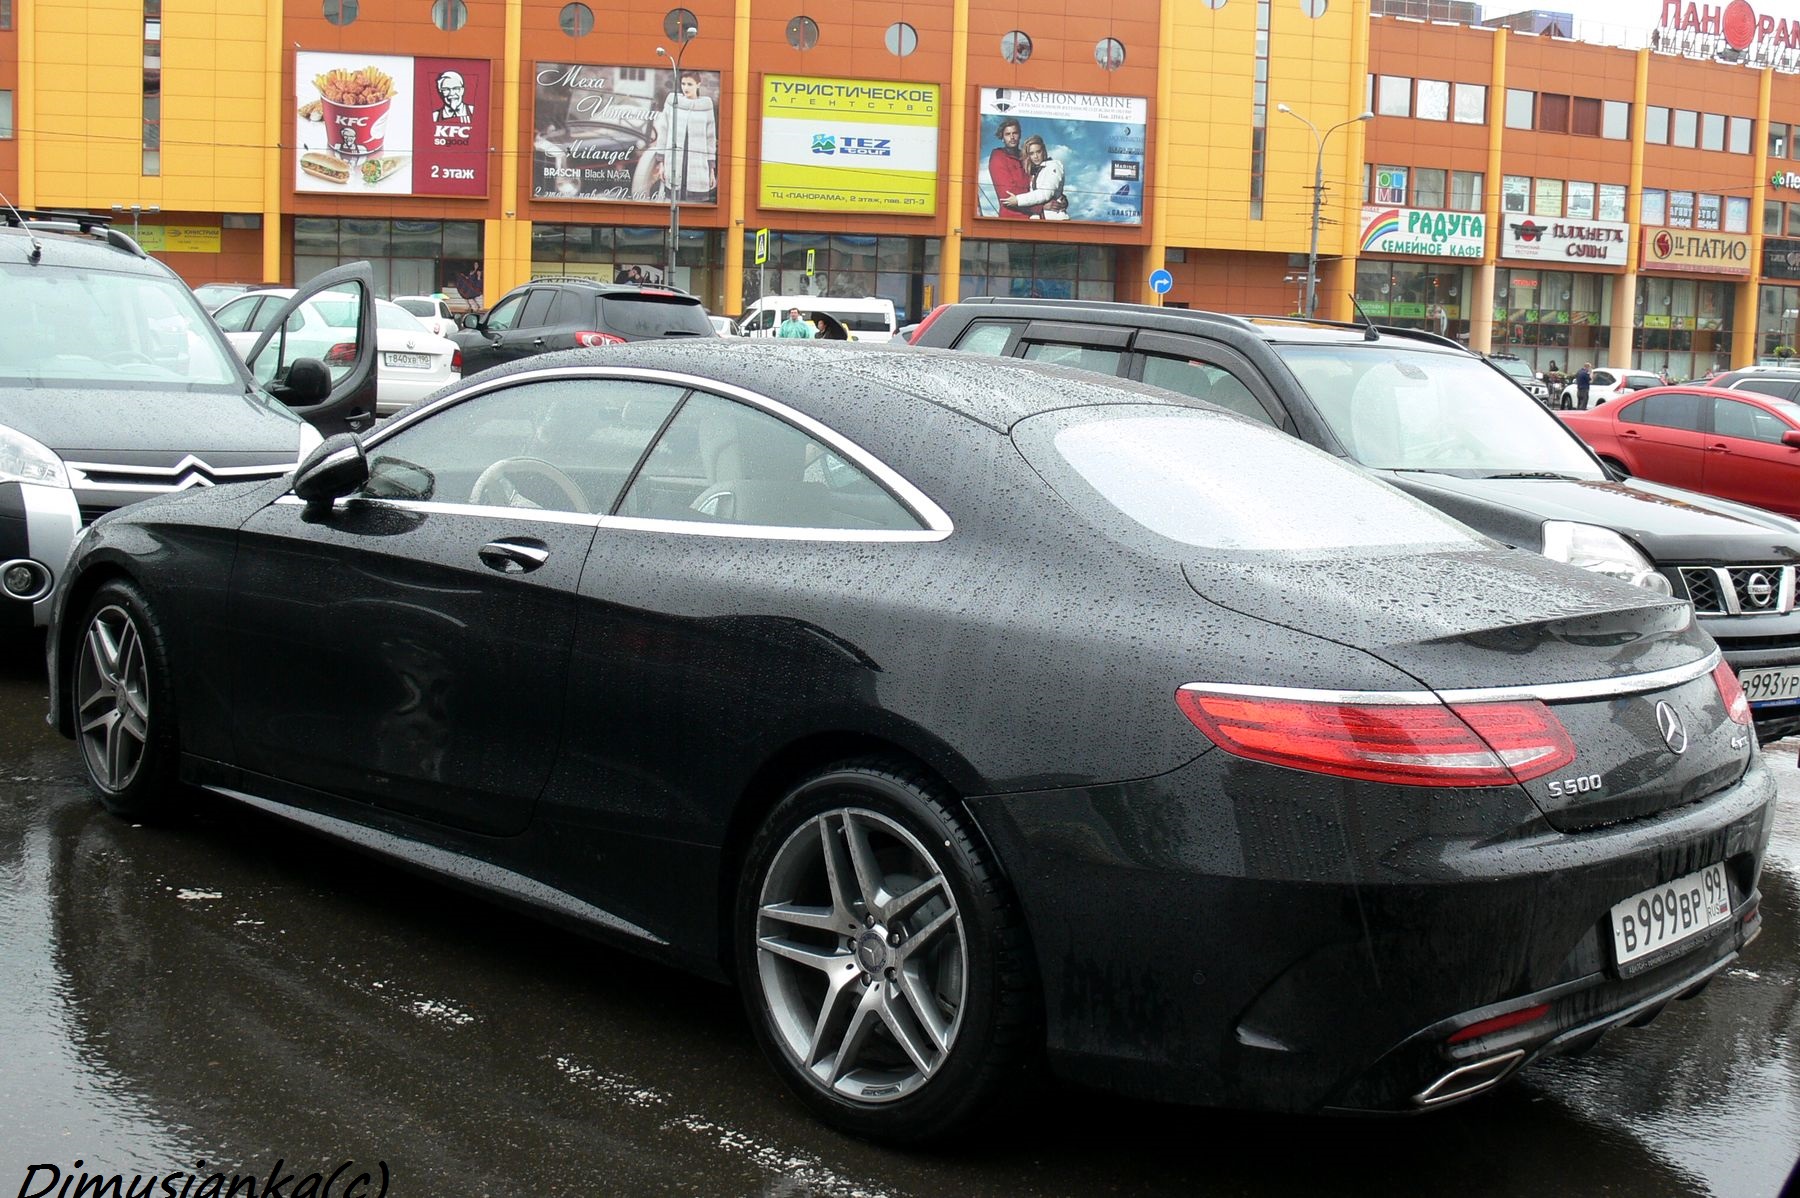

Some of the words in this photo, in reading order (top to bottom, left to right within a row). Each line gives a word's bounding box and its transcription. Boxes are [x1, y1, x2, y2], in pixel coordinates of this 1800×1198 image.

[536, 65, 606, 89] Меха
[770, 81, 933, 103] ТУРИСТИЧЕСКОЕ
[1018, 91, 1079, 105] FASHION
[1080, 95, 1133, 109] MARINE
[335, 115, 370, 127] KFC
[433, 125, 471, 138] KFC
[840, 137, 891, 149] TEZ
[845, 148, 887, 156] tour
[431, 165, 439, 178] 2
[442, 167, 475, 179] этаж
[543, 167, 581, 178] BRASCHI
[584, 168, 605, 179] Black
[771, 191, 784, 199] ТЦ
[1408, 211, 1483, 243] РАДУГА
[1552, 223, 1624, 243] ПЛАНЕТА
[1381, 236, 1442, 255] СЕМЕЙНОЕ
[1450, 244, 1482, 257] КАФЕ
[1566, 243, 1608, 259] СУШИ
[1687, 237, 1747, 261] ПАТИО
[1622, 888, 1701, 953] В999ВР
[1705, 867, 1722, 904] 99
[1707, 902, 1720, 917] RUS
